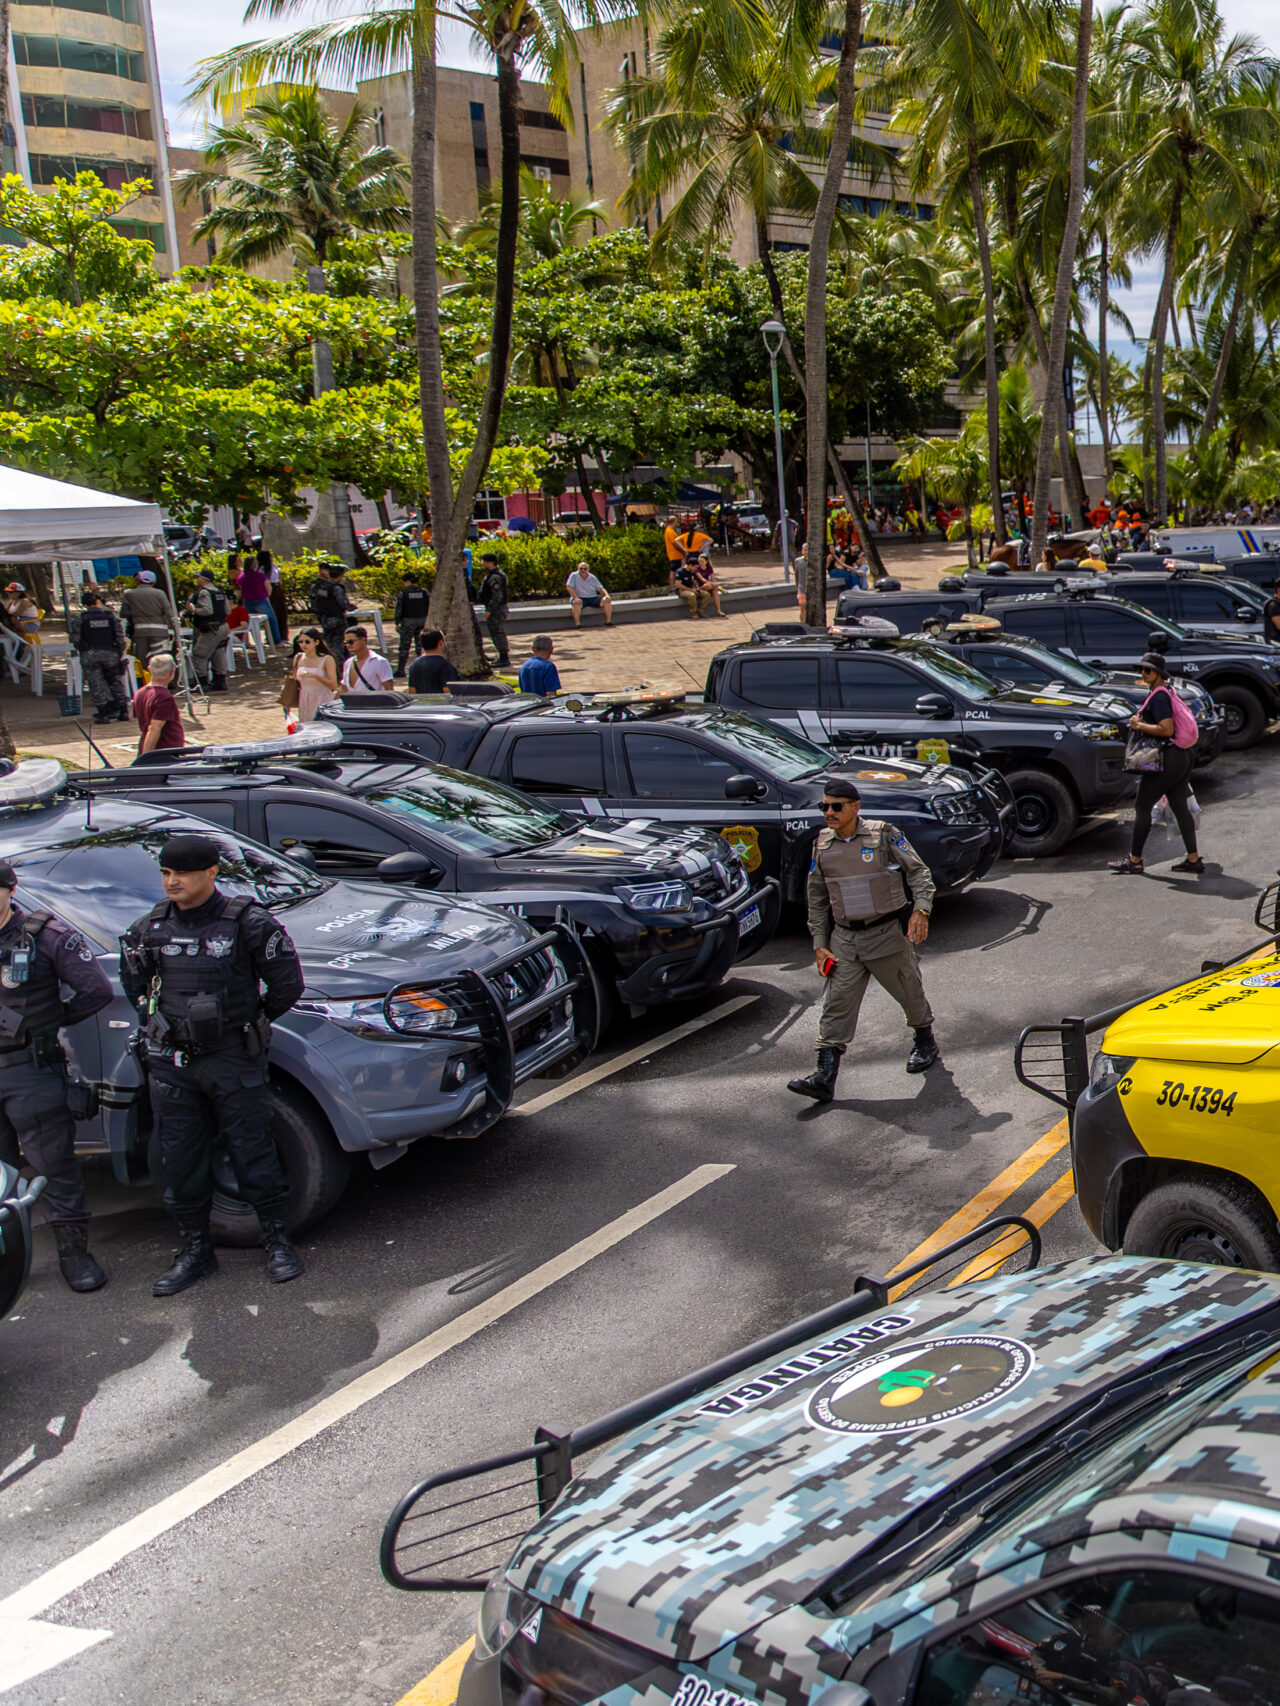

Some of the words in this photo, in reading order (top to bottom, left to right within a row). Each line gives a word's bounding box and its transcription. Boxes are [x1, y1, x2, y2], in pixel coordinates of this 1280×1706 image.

[965, 710, 991, 720] PCAL
[786, 820, 811, 832] PCAL
[314, 908, 383, 933] POLÍCIA
[426, 924, 487, 951] MILITAR
[1157, 1080, 1238, 1117] 30-1394
[924, 1336, 1002, 1349] COMPANHIA
[694, 1315, 915, 1418] CAATINGA
[830, 1353, 891, 1385] COPES
[1001, 1347, 1026, 1387] OPERAÇÕES
[819, 1396, 837, 1422] SERTÃO
[932, 1386, 1001, 1422] POLICIAIS
[834, 1417, 852, 1430] DO
[850, 1411, 928, 1431] ESPECIAIS
